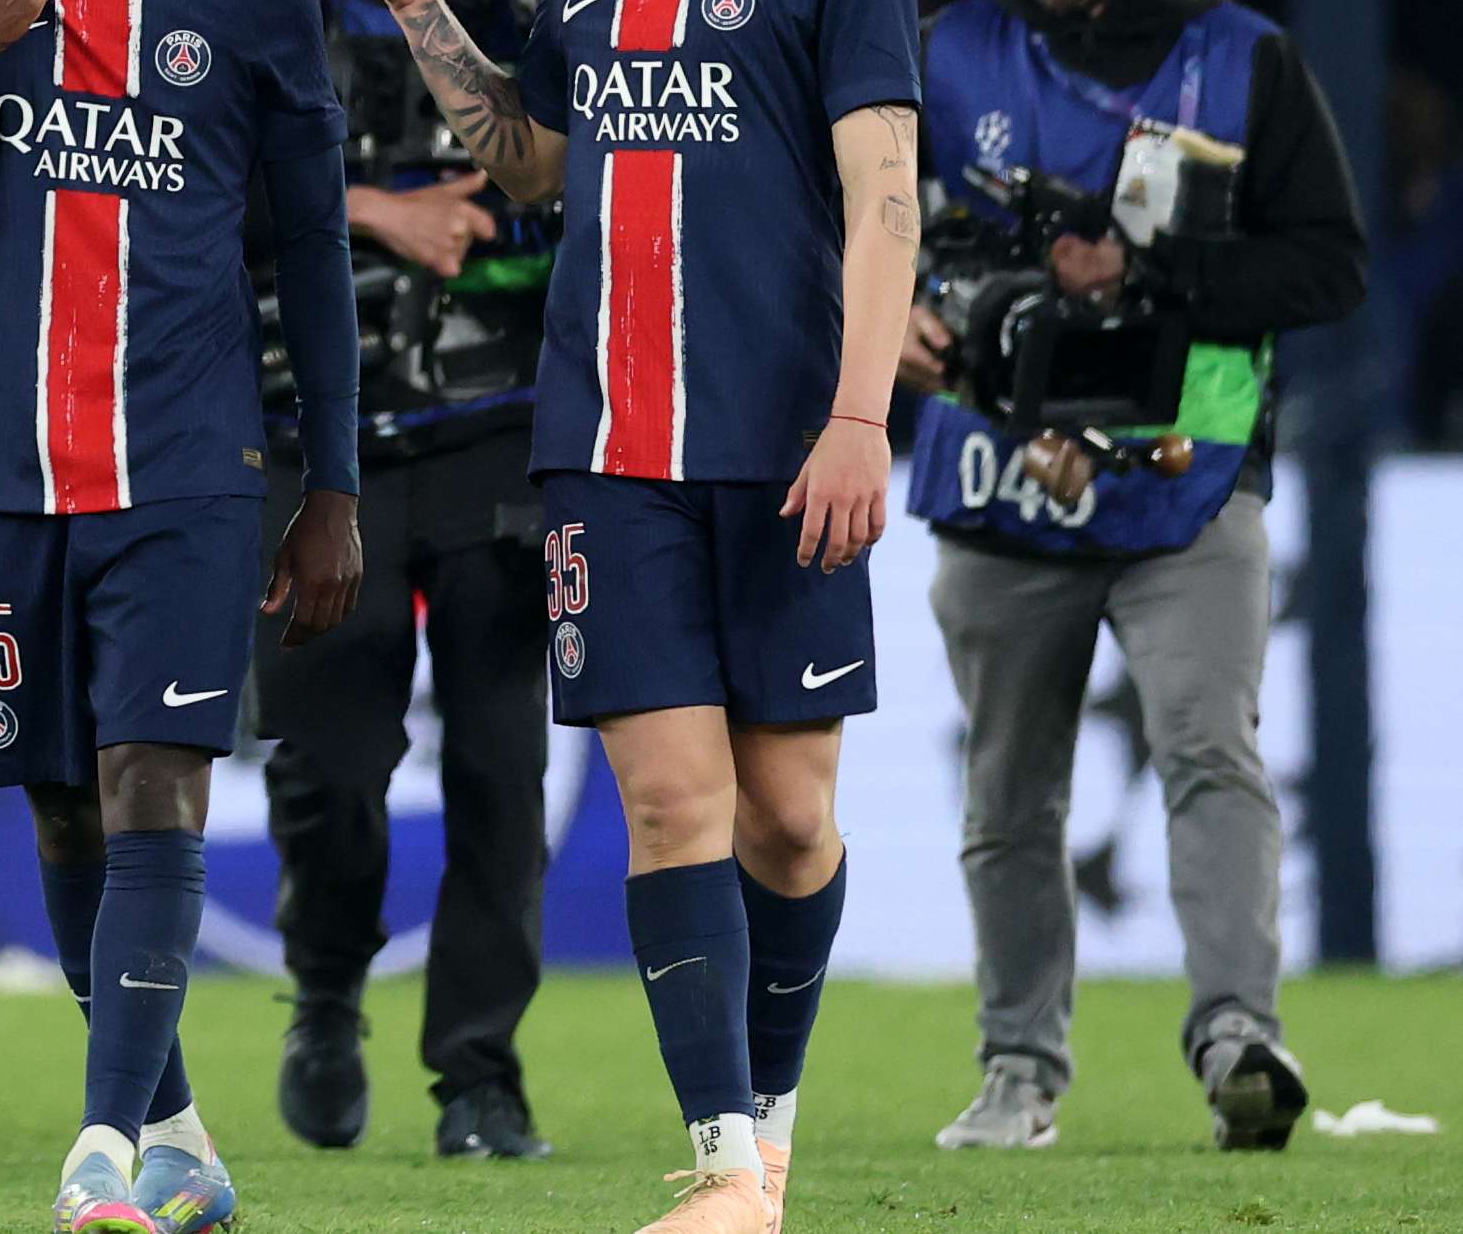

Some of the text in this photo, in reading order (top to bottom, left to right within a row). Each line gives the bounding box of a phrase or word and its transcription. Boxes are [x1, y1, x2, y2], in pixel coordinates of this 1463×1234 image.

[166, 33, 203, 48] PARIS
[573, 60, 739, 120] QATAR
[595, 112, 740, 142] AIRWAYS
[33, 149, 185, 192] AIRWAYS
[544, 523, 589, 622] 35
[699, 1125, 721, 1145] LB
